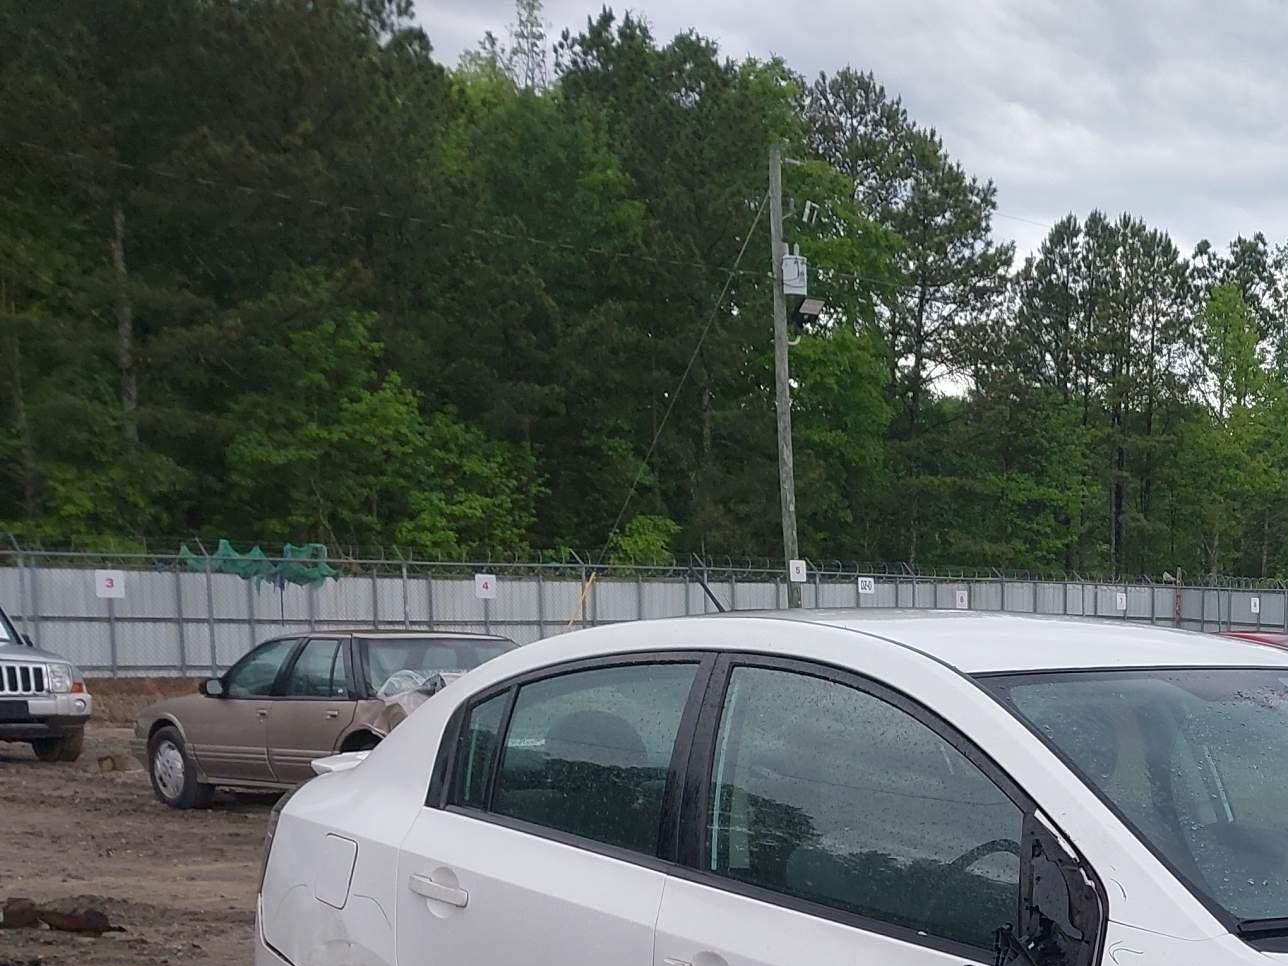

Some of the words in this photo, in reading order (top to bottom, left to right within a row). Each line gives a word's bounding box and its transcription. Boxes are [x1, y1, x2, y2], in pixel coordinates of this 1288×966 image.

[795, 566, 801, 575] 5
[105, 578, 114, 589] 3
[482, 581, 489, 590] 4
